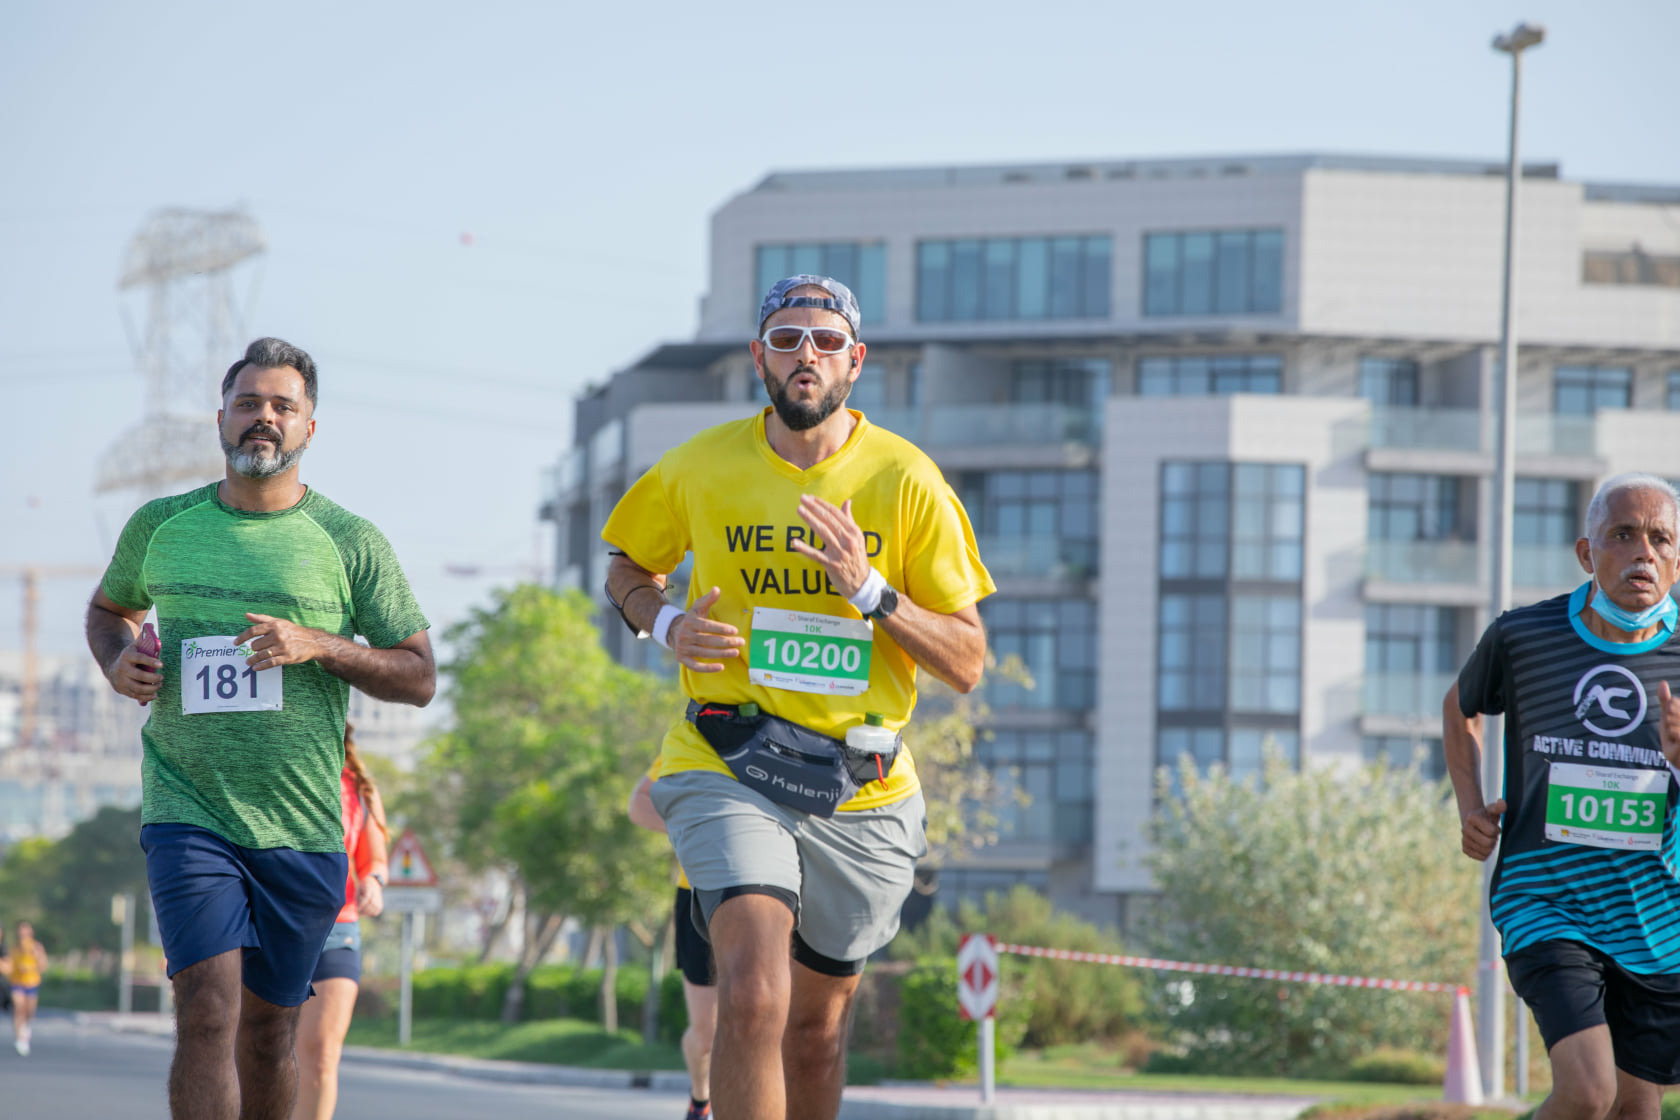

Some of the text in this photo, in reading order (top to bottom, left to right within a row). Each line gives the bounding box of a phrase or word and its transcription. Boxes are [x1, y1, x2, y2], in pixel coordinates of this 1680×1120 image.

[725, 525, 882, 558] WE BUD
[805, 624, 822, 633] 10K
[816, 617, 840, 626] Exchange
[195, 645, 256, 658] PremierSp
[763, 637, 861, 672] 10200
[196, 664, 257, 699] 181
[1533, 735, 1584, 757] ACTIVE
[771, 775, 840, 803] Kalenji
[1602, 780, 1620, 789] 10K
[1561, 793, 1656, 827] 10153
